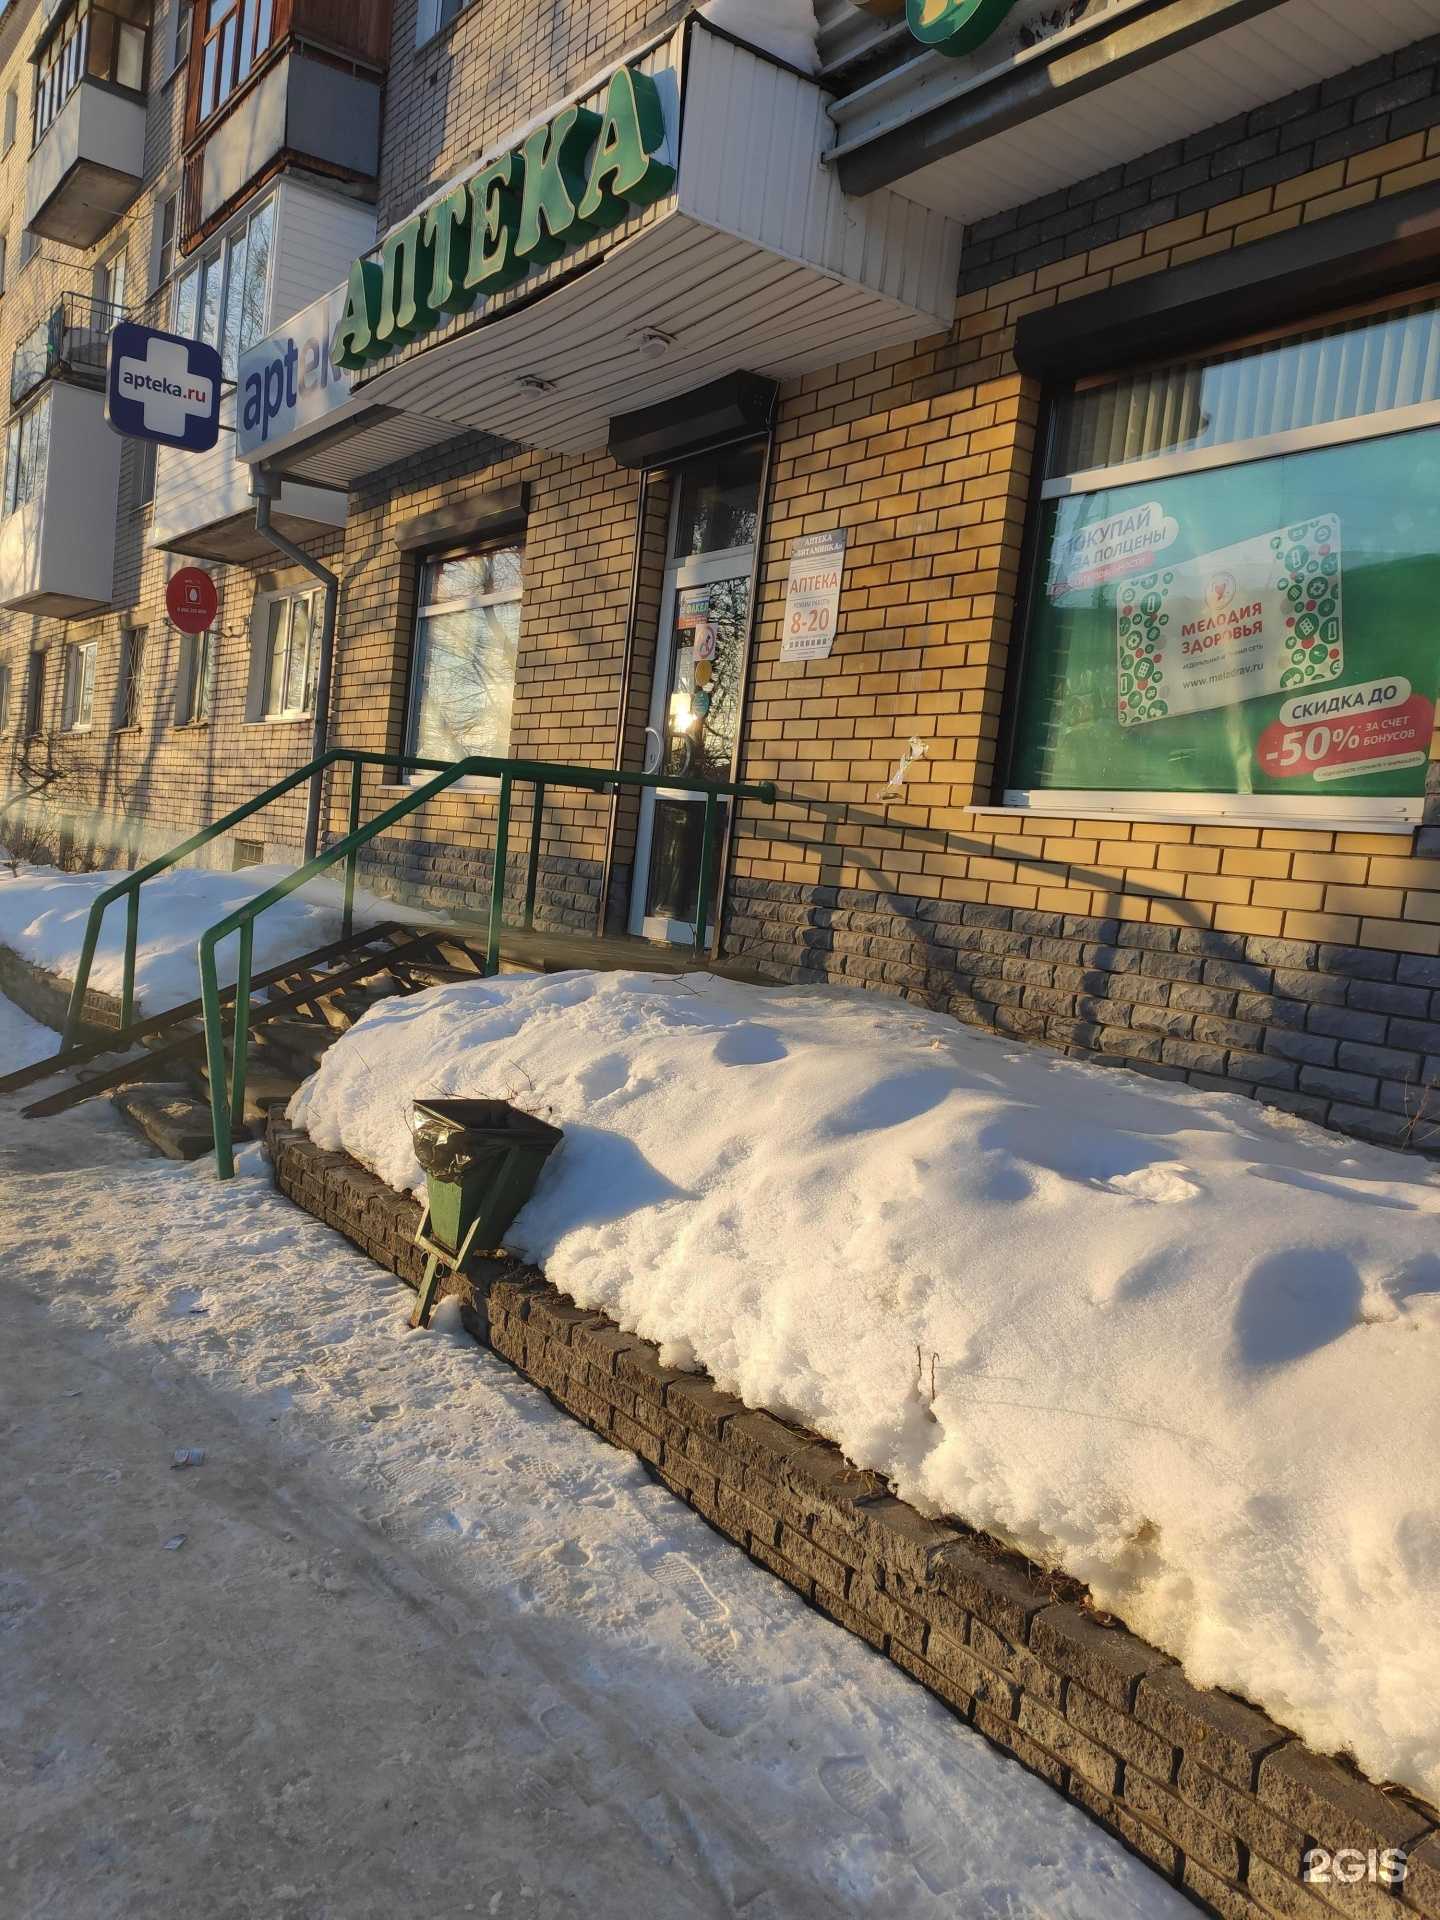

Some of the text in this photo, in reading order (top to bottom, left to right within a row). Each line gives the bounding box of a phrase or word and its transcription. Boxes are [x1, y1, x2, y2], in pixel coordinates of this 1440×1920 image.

[331, 65, 654, 366] АПТЕКА
[123, 371, 206, 404] apteka.ru
[243, 302, 350, 441] aptek
[804, 533, 833, 547] АПТЕКА
[1094, 527, 1167, 563] ПОЛЦЕНЫ
[790, 572, 838, 593] АПТЕКА
[790, 608, 830, 634] 8-20
[1181, 602, 1262, 637] МЕЛОДИЯ
[1181, 620, 1263, 655] ЗДОРОВЬЯ
[1291, 685, 1398, 719] СКИДКА ДО
[1363, 729, 1416, 746] БОНУСОВ
[1364, 716, 1411, 732] ЗА СЧЕТ
